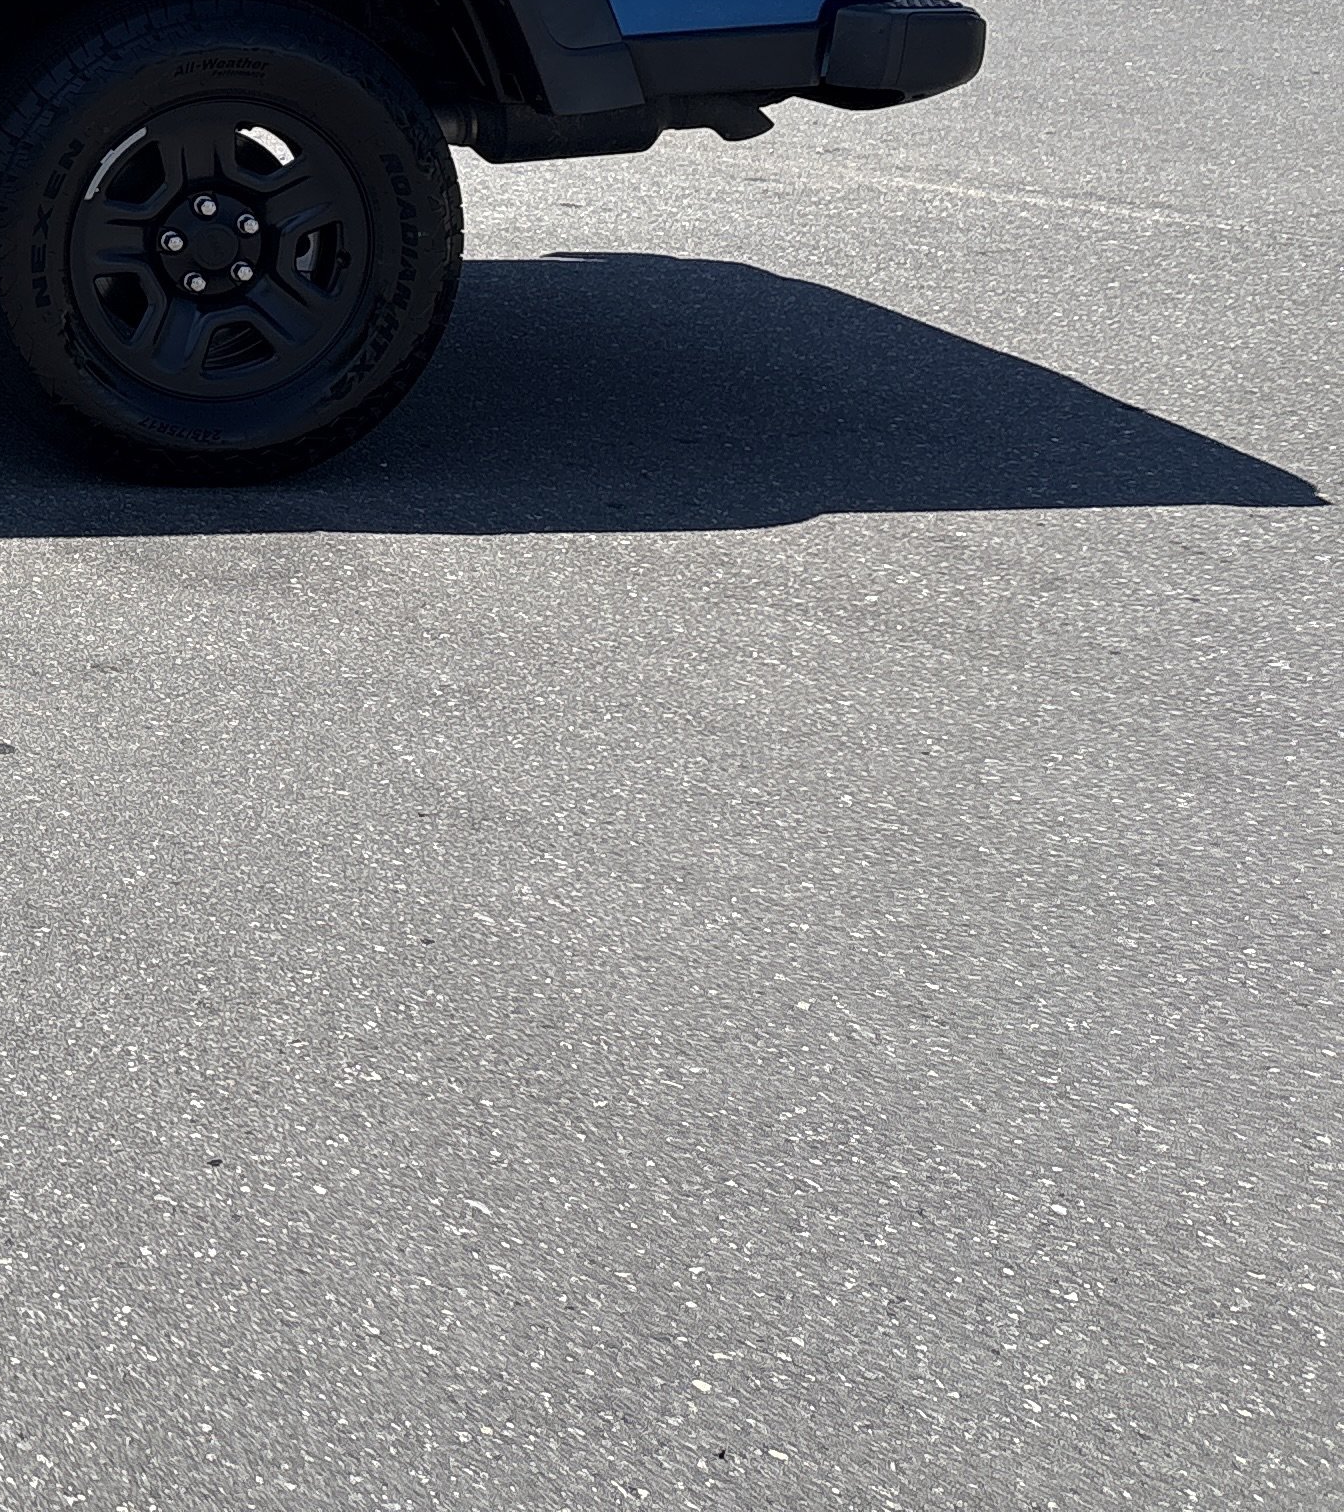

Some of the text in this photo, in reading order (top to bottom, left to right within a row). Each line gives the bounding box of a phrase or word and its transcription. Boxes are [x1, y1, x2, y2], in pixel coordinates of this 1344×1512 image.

[174, 57, 272, 77] All-Weather
[31, 137, 86, 308] NEXEN
[379, 153, 419, 311] ROADIAN
